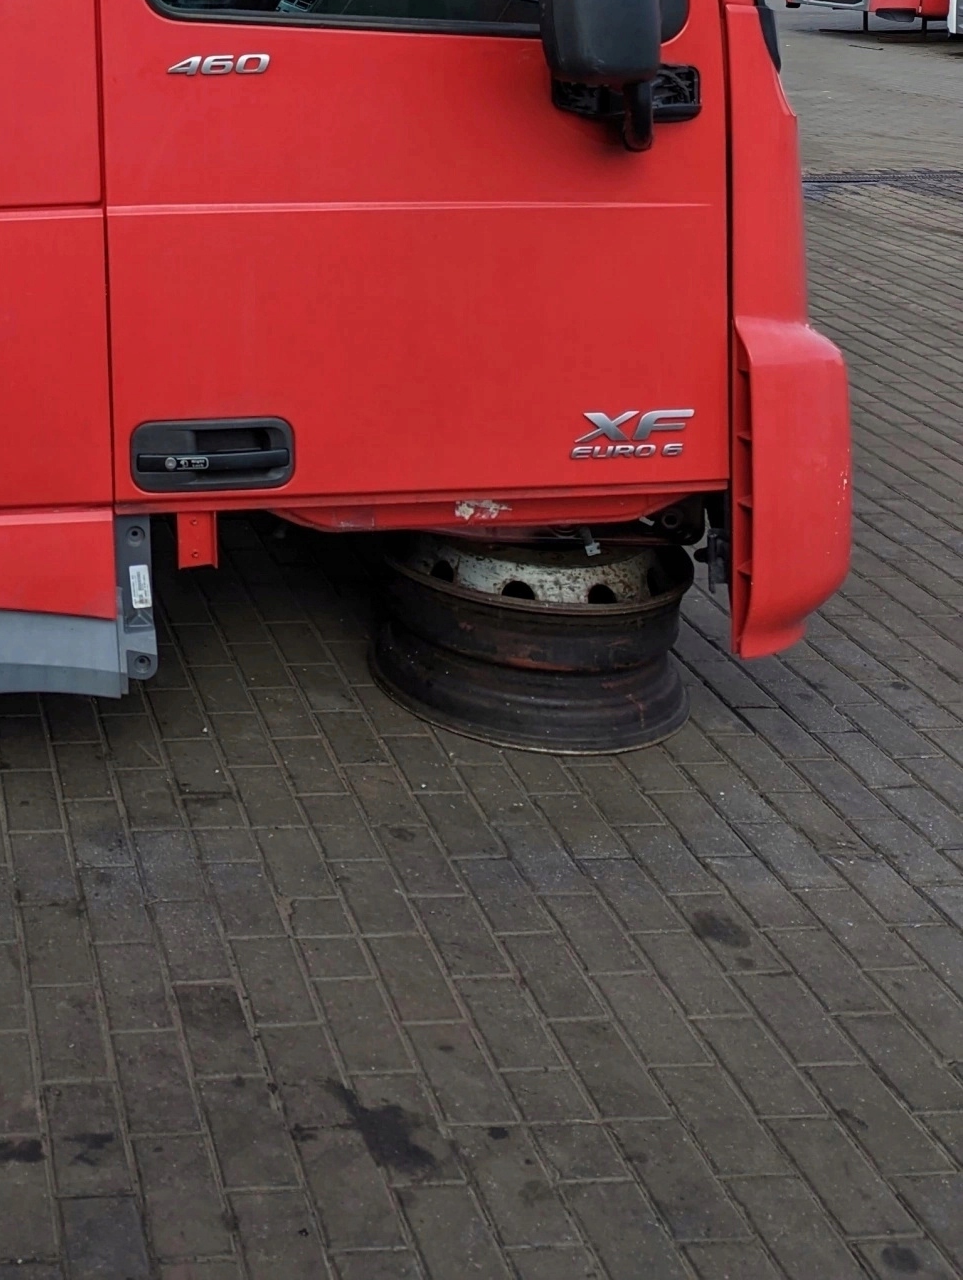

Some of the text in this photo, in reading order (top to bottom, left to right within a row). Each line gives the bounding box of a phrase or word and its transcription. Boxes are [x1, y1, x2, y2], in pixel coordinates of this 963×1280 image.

[167, 53, 270, 76] 460
[574, 409, 695, 443] XF
[570, 442, 684, 460] EURO 6
